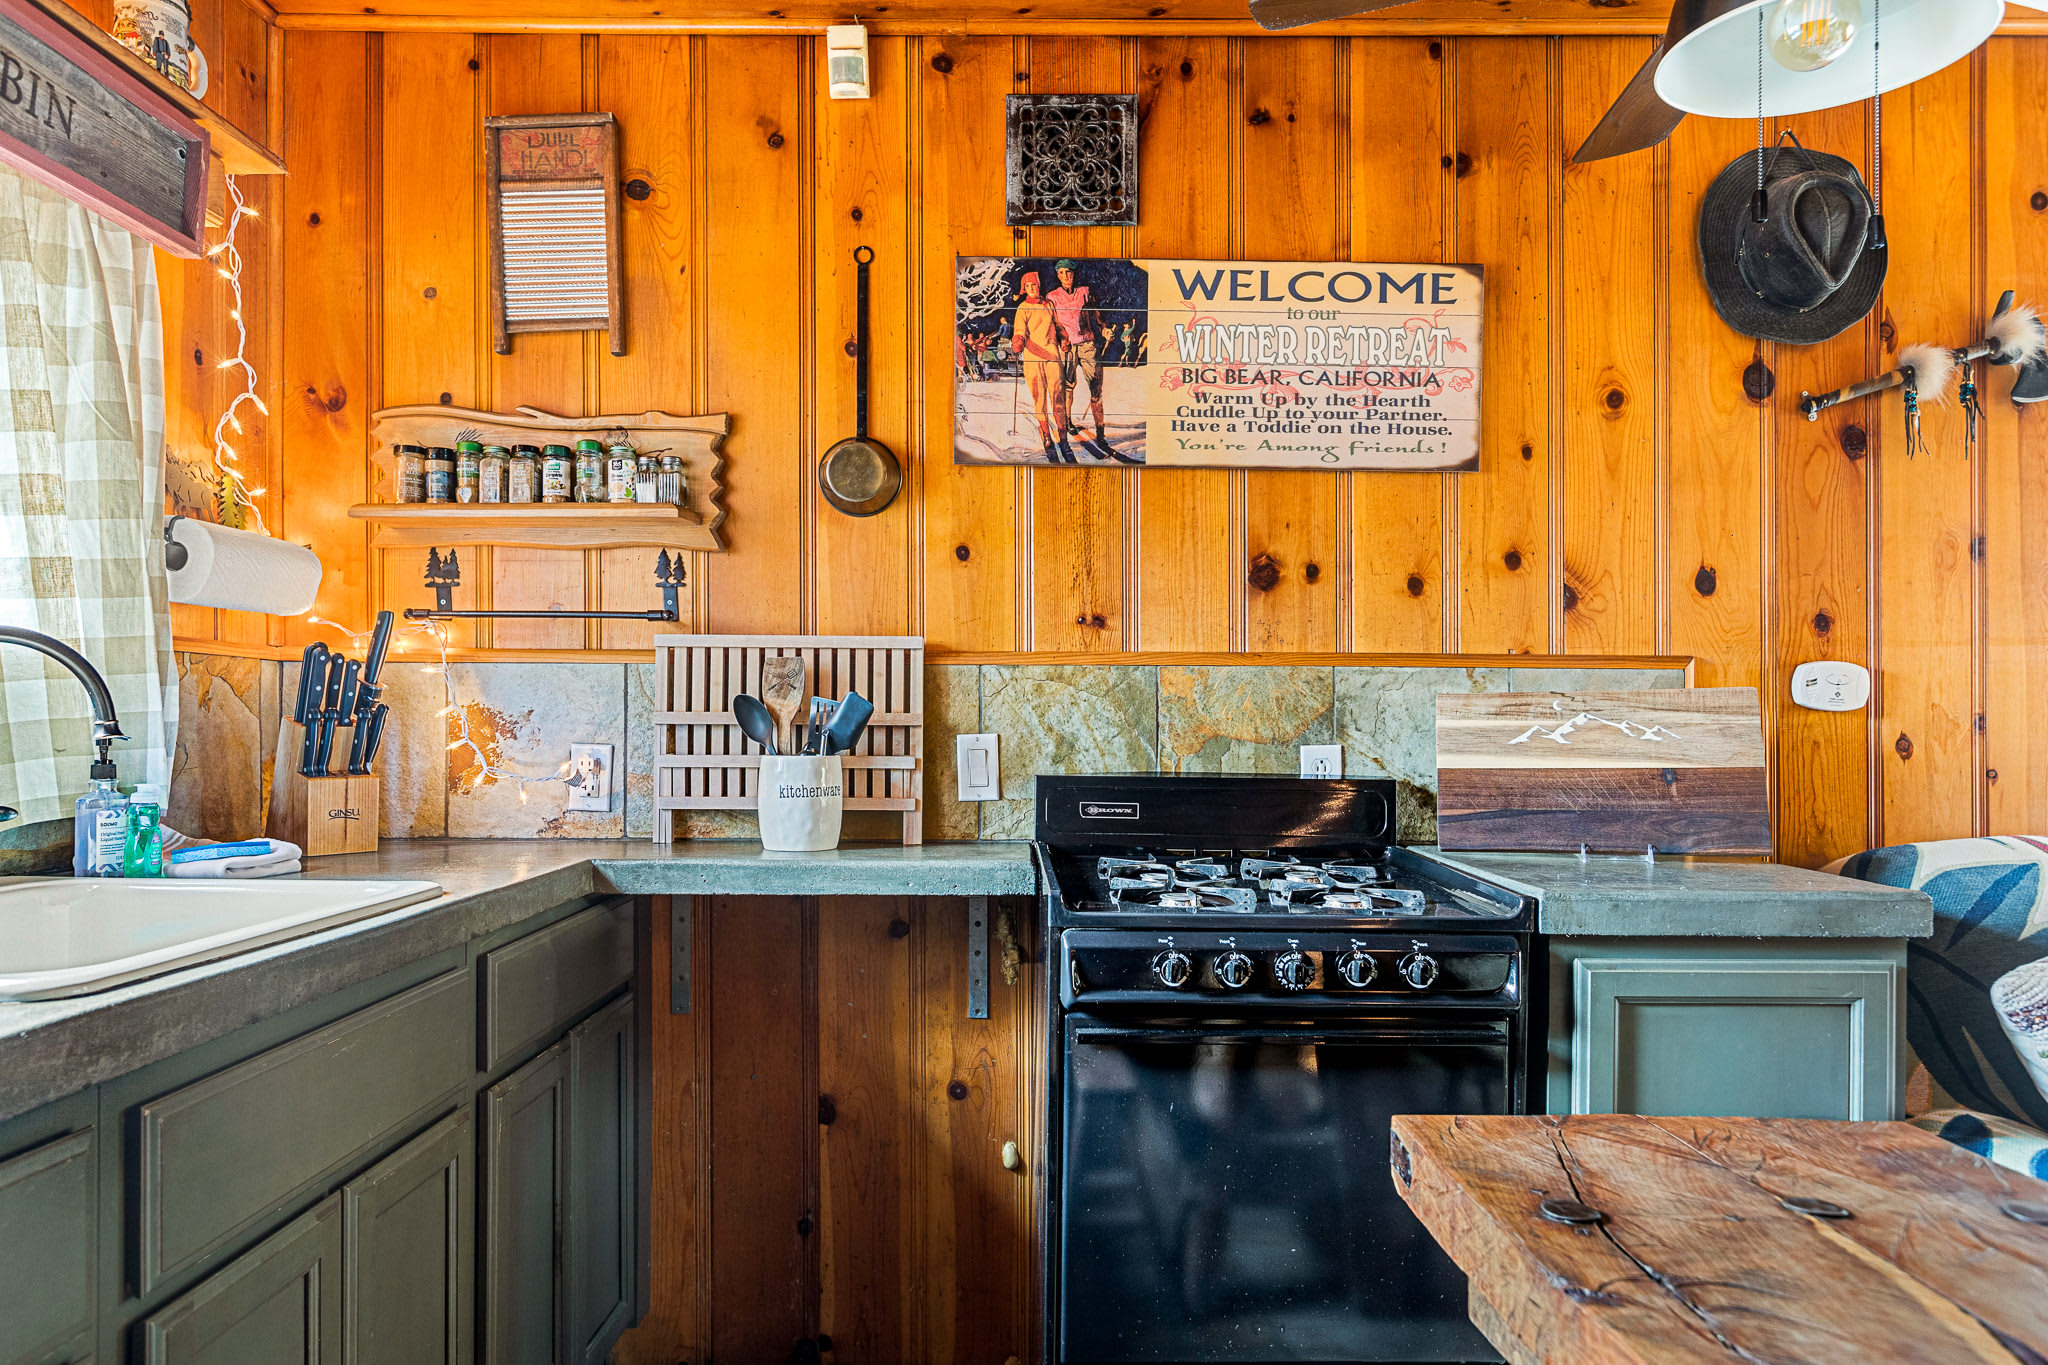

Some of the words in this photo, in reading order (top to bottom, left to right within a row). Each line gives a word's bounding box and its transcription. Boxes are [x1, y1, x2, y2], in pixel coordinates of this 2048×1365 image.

[0, 50, 77, 140] BIN
[521, 149, 588, 169] HANDI
[1171, 268, 1458, 305] WELCOME
[1287, 307, 1304, 320] to
[1308, 308, 1341, 321] our
[1174, 323, 1299, 366] WINTER
[1303, 324, 1452, 368] RETREAT
[1181, 368, 1218, 384] BIG
[1225, 368, 1291, 386] BEAR,
[1298, 369, 1442, 388] CALIFORNIA
[1193, 392, 1254, 405] Warm
[1260, 392, 1287, 409] Up
[1294, 392, 1318, 410] by
[1325, 393, 1356, 407] the
[1363, 394, 1431, 408] Hearth
[1176, 405, 1246, 418] Cuddle
[1251, 406, 1279, 422] Up
[1285, 408, 1305, 420] to
[1310, 409, 1359, 424] your
[1365, 408, 1448, 422] Partner.
[1170, 419, 1220, 433] Have
[1226, 422, 1237, 433] a
[1317, 424, 1342, 434] on
[1349, 421, 1381, 435] the
[1386, 422, 1453, 436] House.
[1175, 438, 1248, 451] You're
[1256, 438, 1340, 463] Among
[779, 784, 841, 799] kitchenware
[328, 808, 360, 818] GINSU
